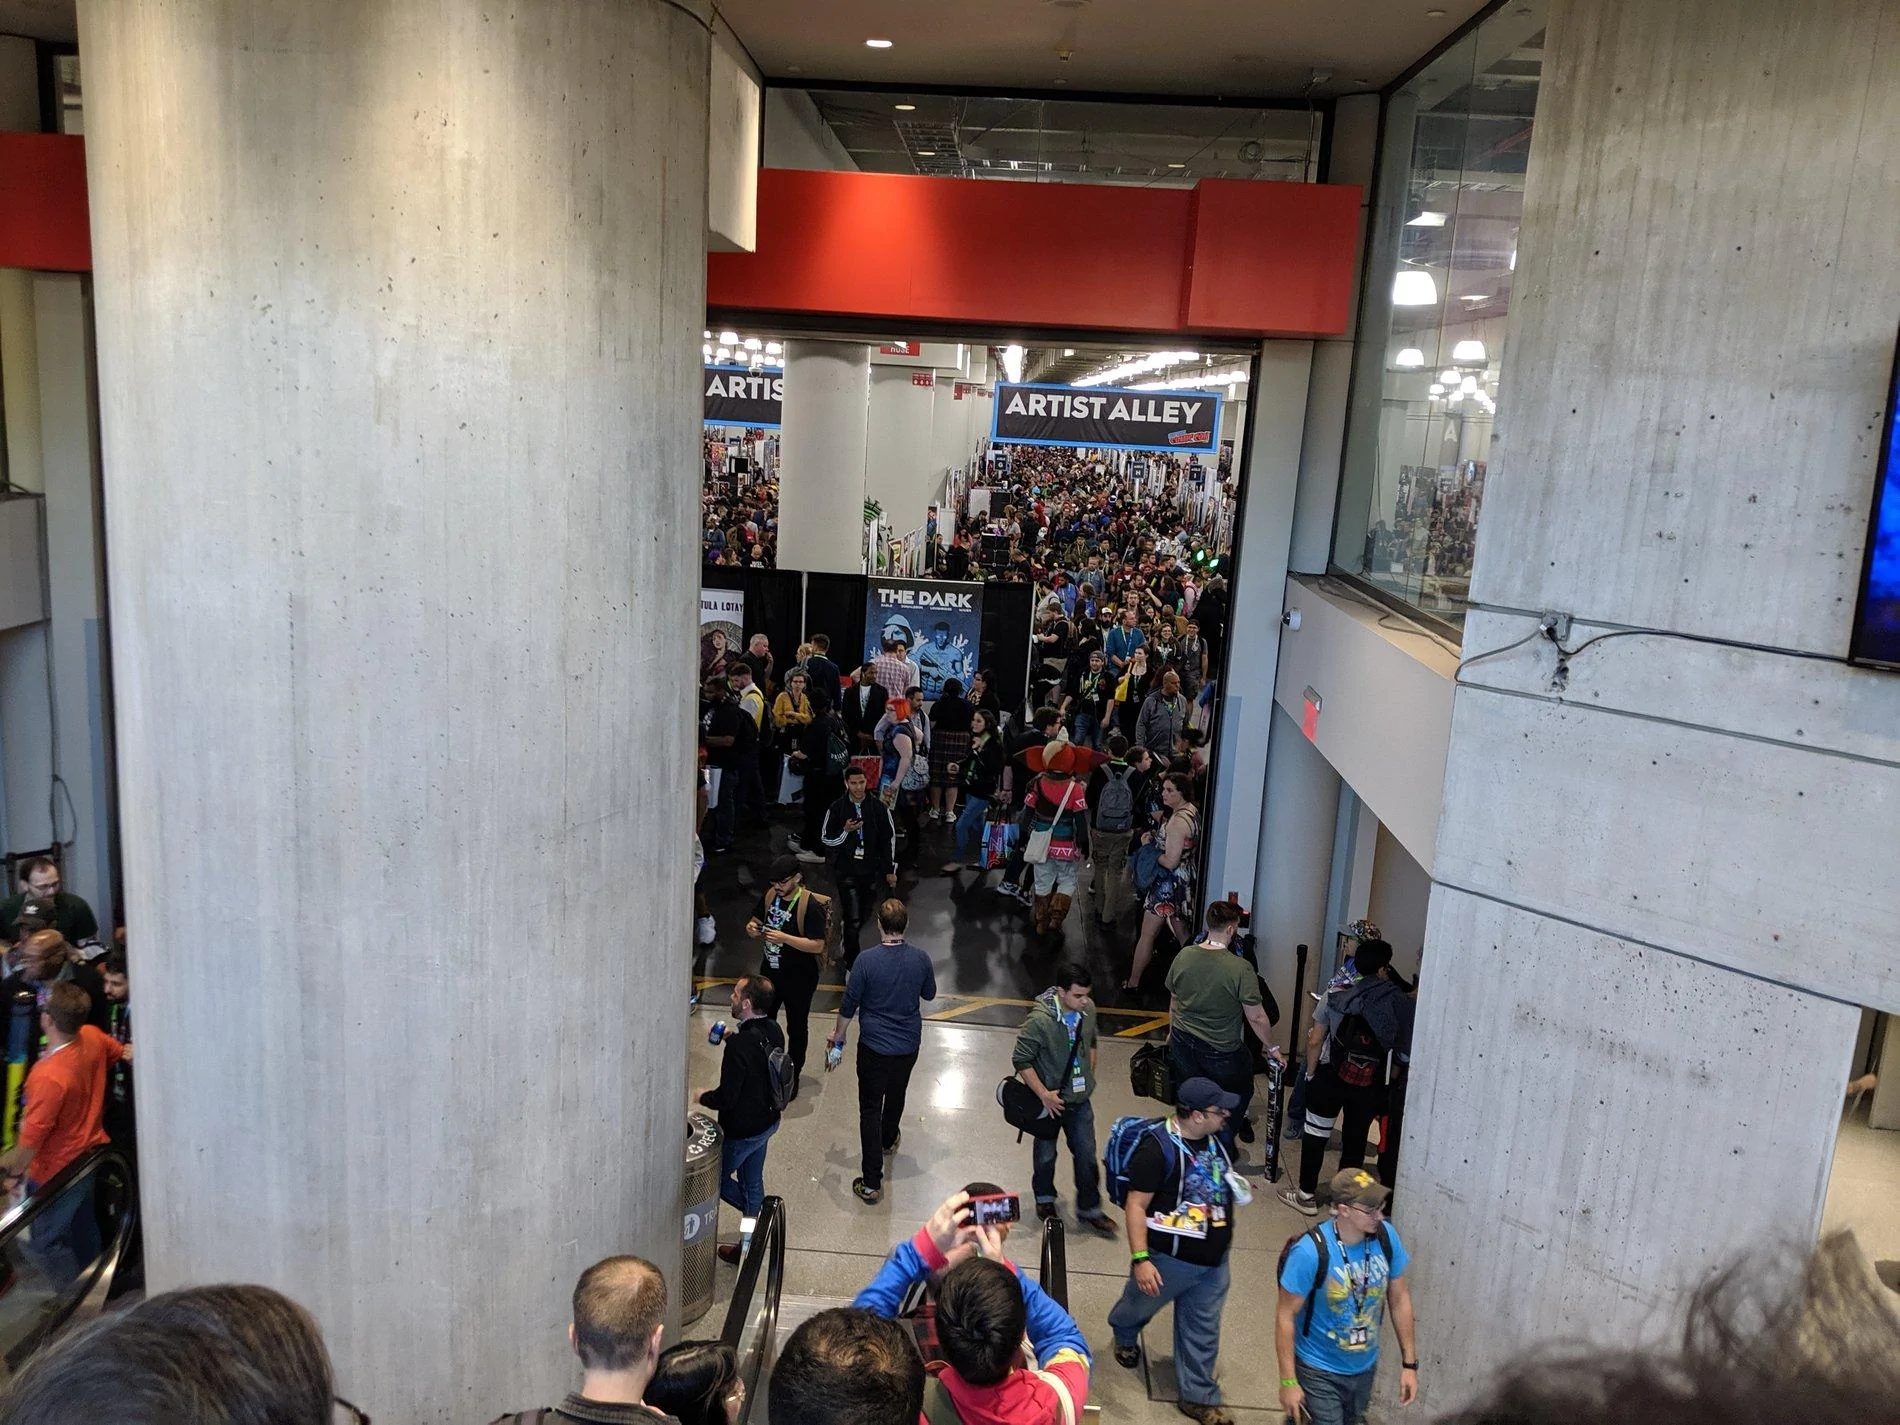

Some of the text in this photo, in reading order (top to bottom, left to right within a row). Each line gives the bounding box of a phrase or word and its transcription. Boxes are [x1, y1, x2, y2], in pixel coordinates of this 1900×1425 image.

[1005, 391, 1202, 424] ARTIST ALLEY
[701, 600, 718, 611] TULA
[878, 588, 973, 608] THE DARK
[691, 1115, 717, 1147] RECYCLE
